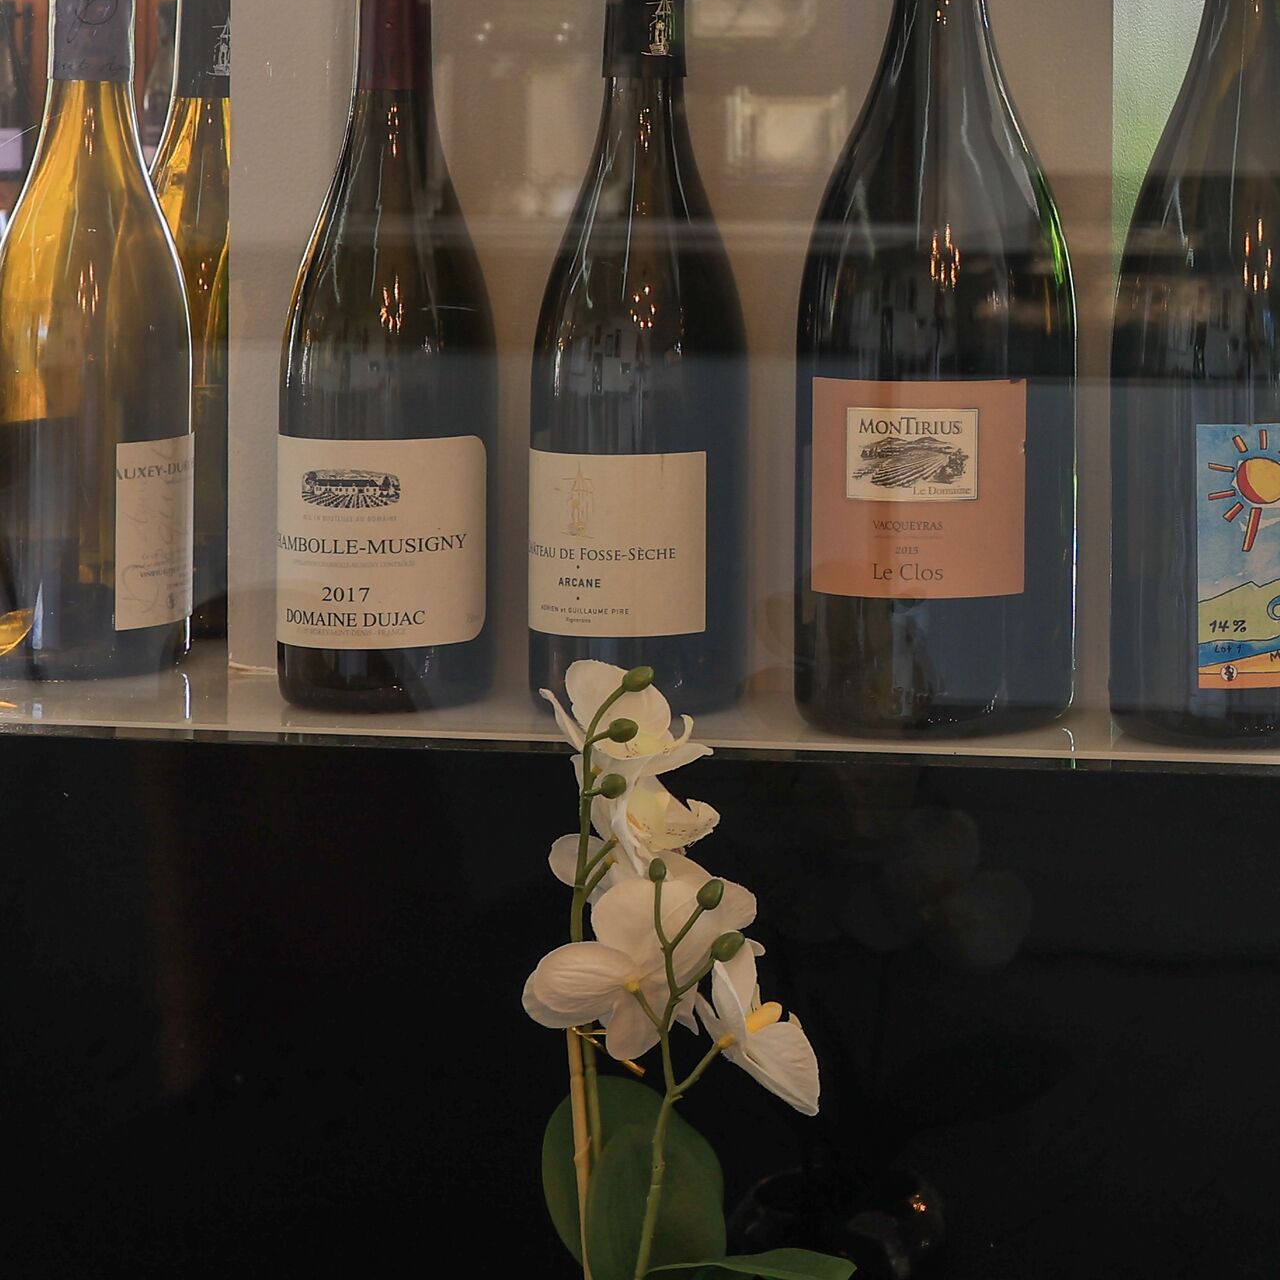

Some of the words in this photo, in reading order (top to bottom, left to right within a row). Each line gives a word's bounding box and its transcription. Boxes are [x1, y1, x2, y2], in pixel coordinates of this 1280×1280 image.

[928, 486, 972, 496] Domaine
[872, 520, 944, 533] VACQUEYRAS
[560, 548, 575, 560] DE
[580, 545, 676, 561] FOSSE-SÈCHE
[872, 563, 893, 581] Le
[899, 563, 944, 581] Clos
[558, 577, 602, 589] ARCANE
[321, 586, 371, 603] 2017
[567, 607, 609, 615] GUILLAUME
[286, 608, 357, 628] DOMAINE
[363, 609, 426, 628] DUJAC
[1214, 644, 1232, 654] Lot
[1236, 644, 1243, 655] 1
